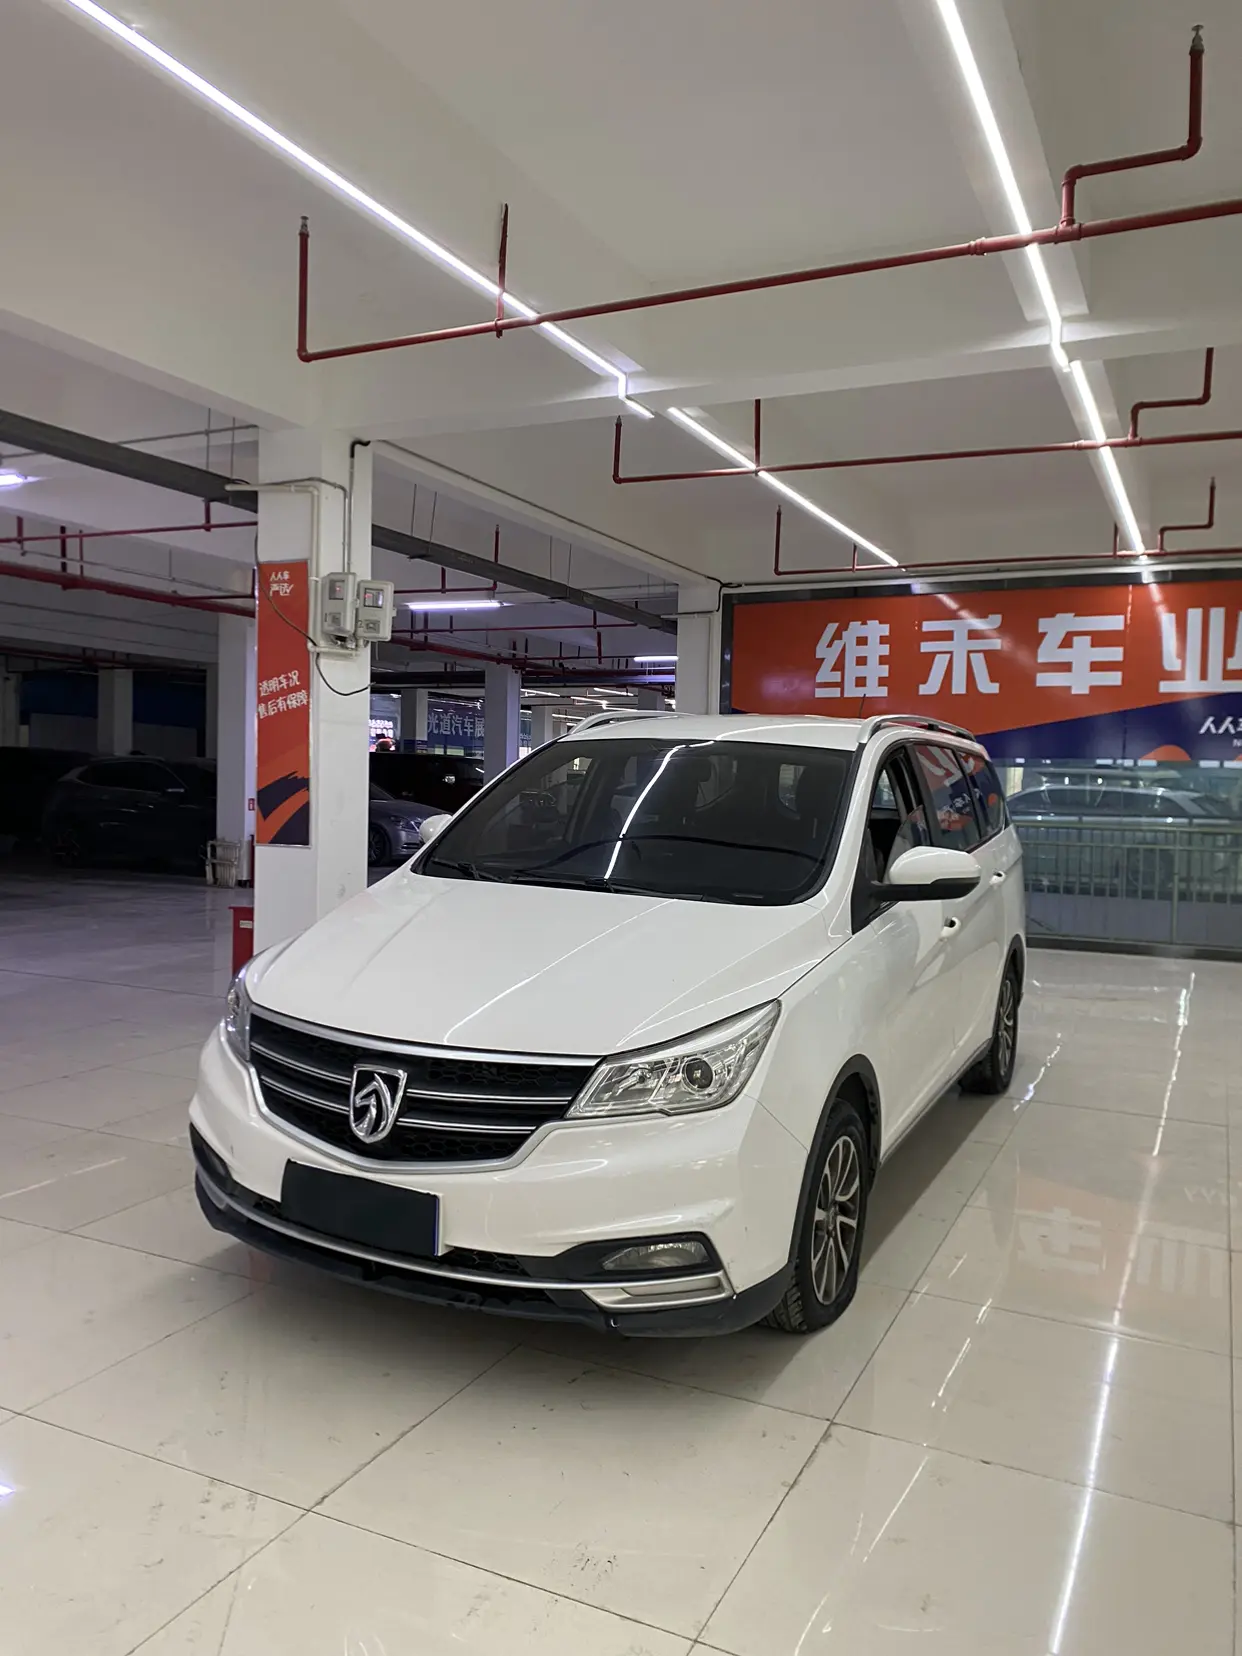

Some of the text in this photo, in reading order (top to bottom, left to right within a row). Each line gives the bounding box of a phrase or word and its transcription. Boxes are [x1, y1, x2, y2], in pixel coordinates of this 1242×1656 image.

[815, 607, 1242, 698] 维禾车业
[259, 670, 300, 696] 透明车况
[258, 690, 308, 719] 售后有保障
